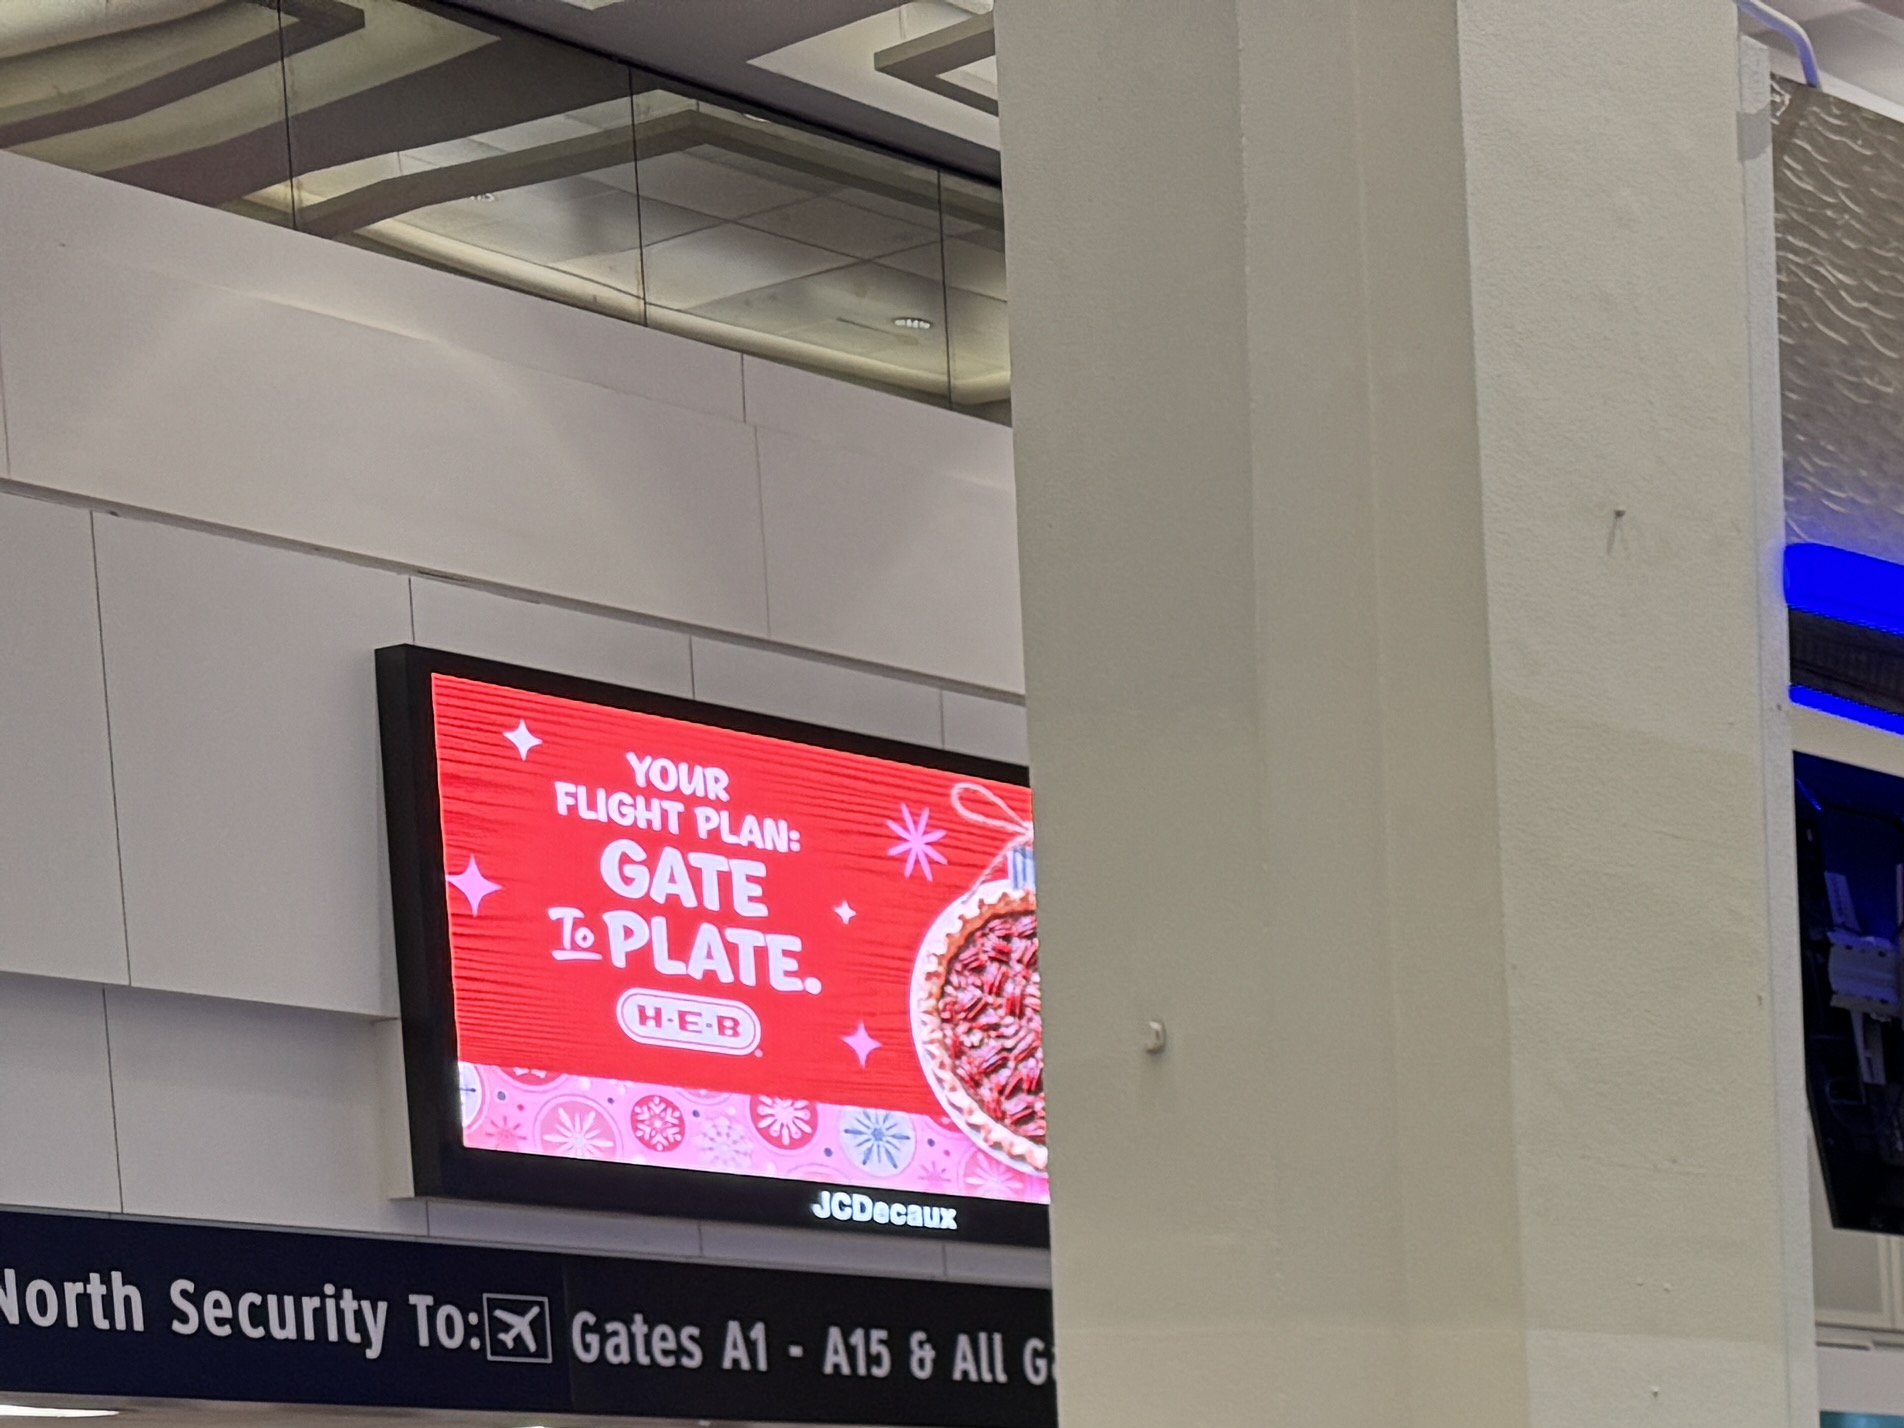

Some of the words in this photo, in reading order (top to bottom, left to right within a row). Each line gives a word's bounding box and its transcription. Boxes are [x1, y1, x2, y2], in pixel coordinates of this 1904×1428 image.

[625, 752, 730, 801] YOUR
[555, 781, 684, 831] FLIGHT
[697, 805, 801, 853] PLAN:
[600, 839, 769, 917] GATE
[603, 911, 822, 995] PLATE.
[809, 1191, 957, 1230] JCDecaux
[170, 1278, 387, 1359] Security
[408, 1293, 481, 1350] To:
[572, 1311, 702, 1368] Gates
[721, 1320, 768, 1371] A1
[823, 1326, 891, 1378] A15
[910, 1330, 936, 1379] &
[952, 1332, 1008, 1383] All
